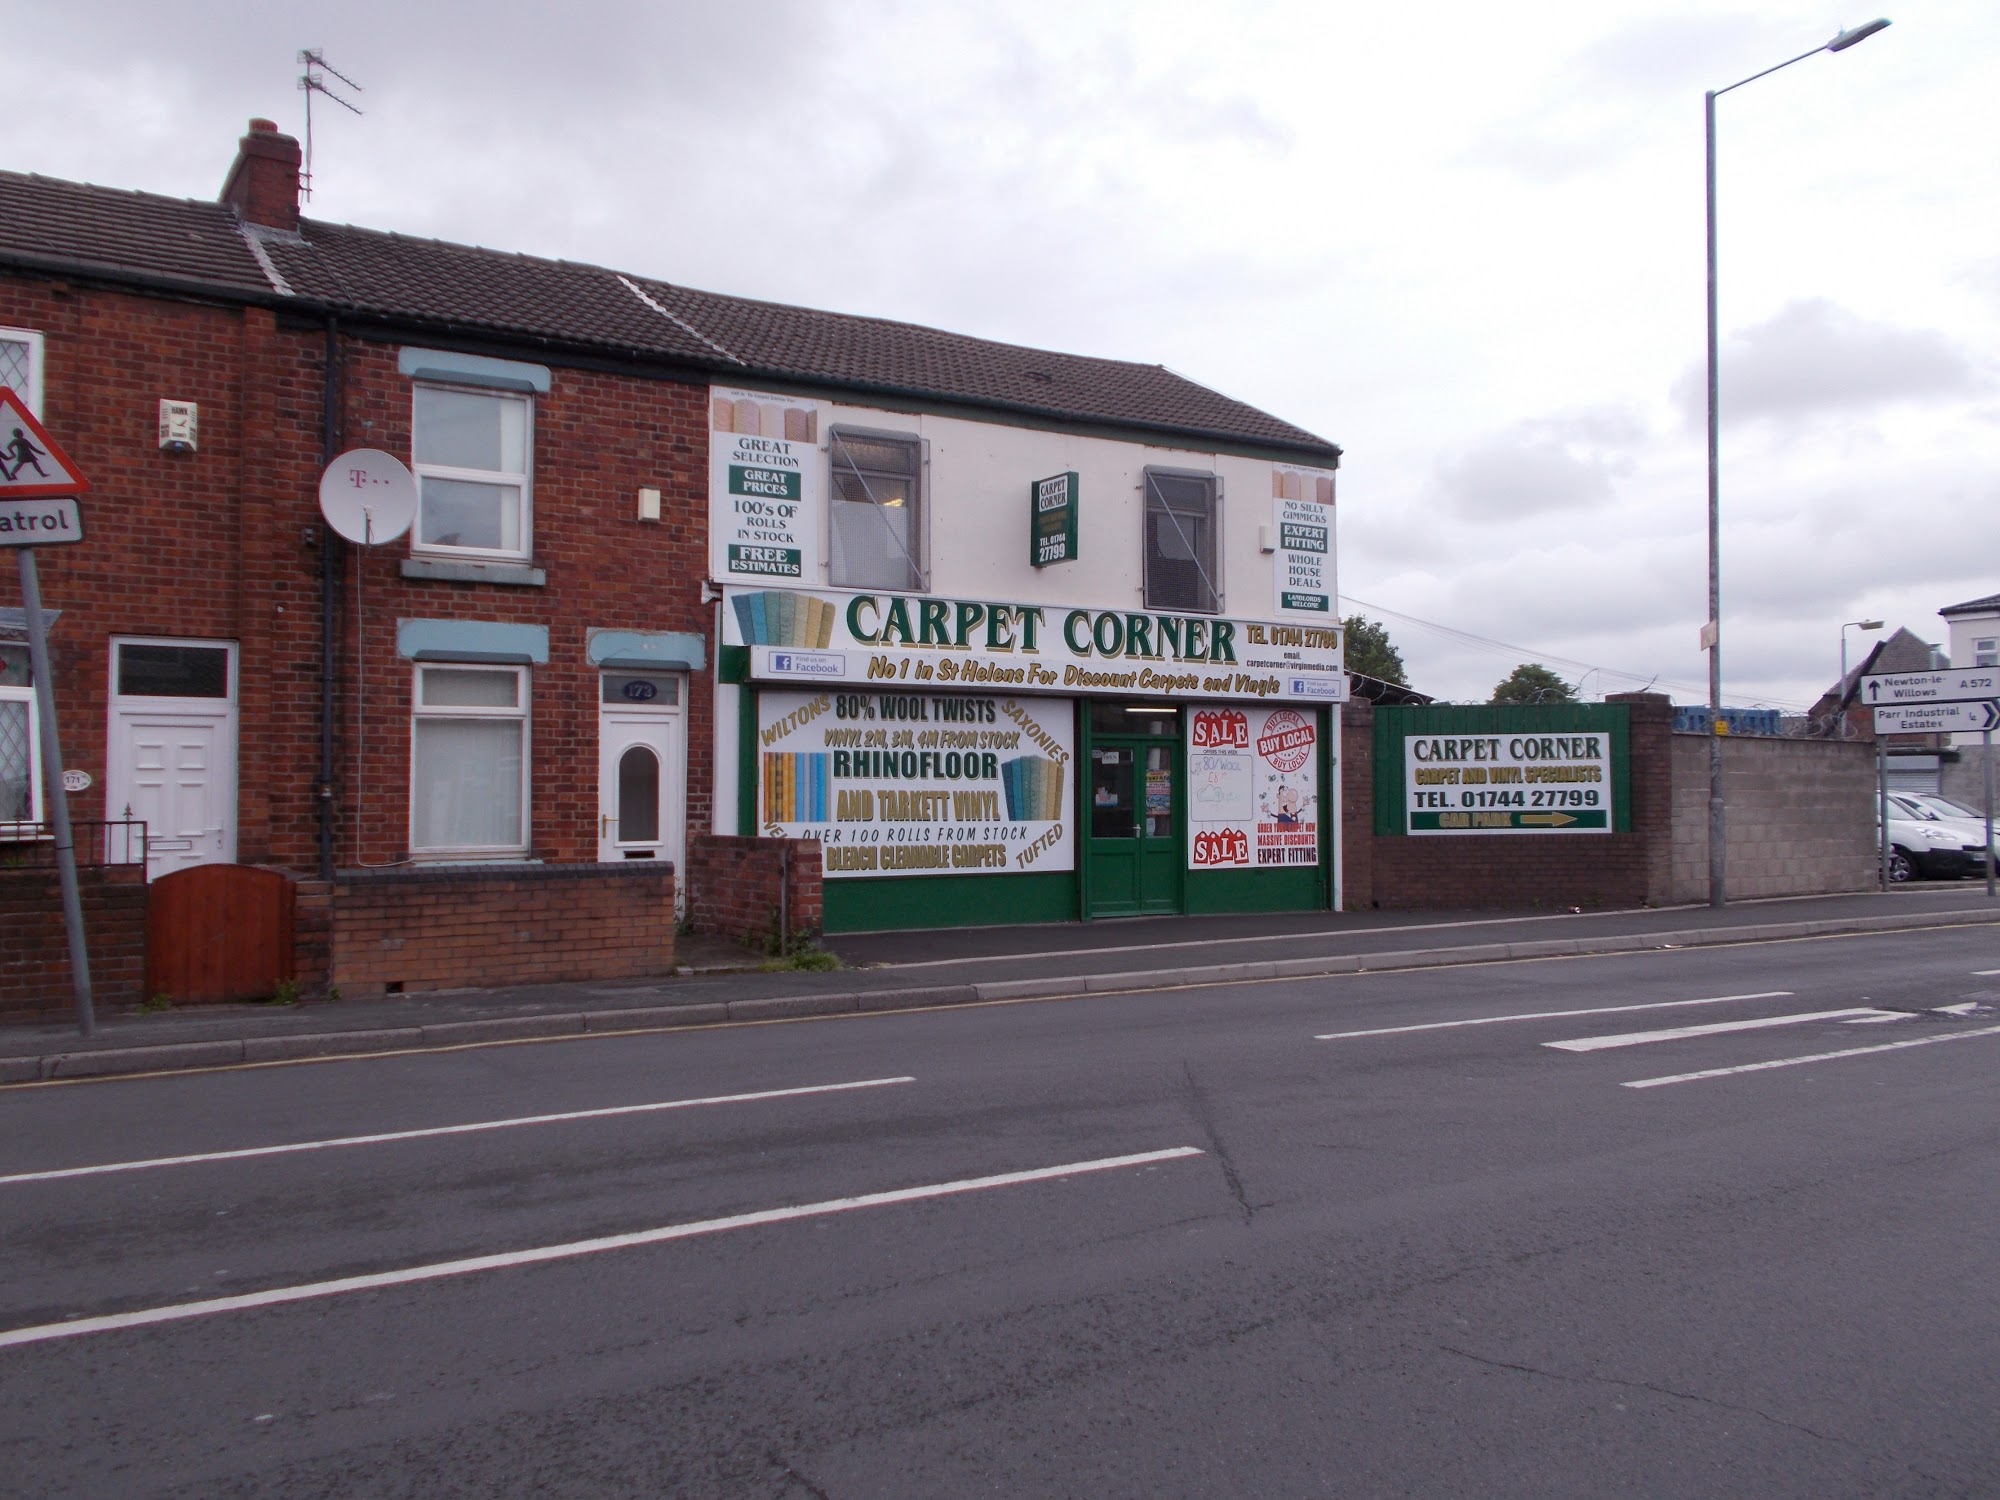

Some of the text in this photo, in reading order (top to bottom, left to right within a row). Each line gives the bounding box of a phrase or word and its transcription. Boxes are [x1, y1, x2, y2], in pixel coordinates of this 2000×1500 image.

[739, 438, 791, 454] GREAT
[733, 451, 798, 467] SELECTION
[744, 470, 786, 483] GREAT
[744, 481, 788, 496] PRICES
[1041, 480, 1065, 496] CARPET
[735, 500, 798, 518] 100's OF
[1041, 493, 1066, 509] CORNER
[1285, 502, 1324, 513] NO SILLY
[747, 517, 786, 529] ROLLS
[1283, 511, 1326, 524] GIMMICKS
[738, 529, 794, 543] IN STOCK
[1040, 533, 1066, 546] TEL. 01744
[1284, 525, 1324, 538] EXPERT
[1284, 537, 1324, 550] FITTING
[740, 547, 787, 562] FREE
[1040, 543, 1065, 562] 27799
[1288, 554, 1322, 566] WHOLE
[731, 560, 799, 574] ESTIMATES
[1289, 566, 1321, 577] HOUSE
[1289, 577, 1321, 588] DEALS
[1288, 594, 1321, 602] LANDLORDS
[1292, 601, 1319, 609] WELCOME
[846, 595, 1238, 666] CARPET CORNER
[1246, 625, 1338, 649] TEL. 01744 27799
[796, 663, 838, 672] Facebook
[1246, 660, 1338, 672] carpetcorner@virginmedia.com
[867, 655, 1280, 697] No 1 in St Helens For Discount Carpets and Vinyls
[1885, 675, 1946, 686] Newton-le-
[1894, 688, 1937, 697] Willows
[836, 695, 997, 724] 80% WOOL TWISTS
[1879, 710, 1901, 719] Parr
[1905, 707, 1959, 718] Industrial
[761, 692, 831, 747] WILTONS
[1267, 712, 1300, 731] BUY LOCAL
[1901, 720, 1936, 728] Estate
[824, 728, 862, 748] VINYL
[917, 729, 939, 750] 4M
[940, 730, 978, 750] FROM
[979, 730, 1020, 750] STOCK
[1002, 700, 1070, 766] SAXONIES
[1195, 720, 1248, 744] SALE
[1260, 729, 1312, 754] BUY LOCAL
[1414, 737, 1602, 762] CARPET CORNER
[834, 750, 998, 780] RHINOFLOOR
[1273, 752, 1306, 769] BUY LOCAL
[66, 776, 80, 784] 171
[1415, 765, 1602, 785] CARPET AND VINYL SPECIALISTS
[836, 790, 1000, 822] AND TARKETT VINYL
[1414, 789, 1599, 807] TEL. 01744 27799
[1439, 812, 1513, 827] CAR PARK
[803, 826, 1027, 843] OVER 100 ROLLS FROM STOCK
[1258, 834, 1315, 846] MASSIVE DISCOUNTS
[1016, 823, 1063, 869] TUFTED
[1196, 838, 1248, 862] SALE
[827, 844, 1006, 871] BLEACH CLEANABLE CARPETS
[1258, 847, 1316, 864] EXPERT FITTING
